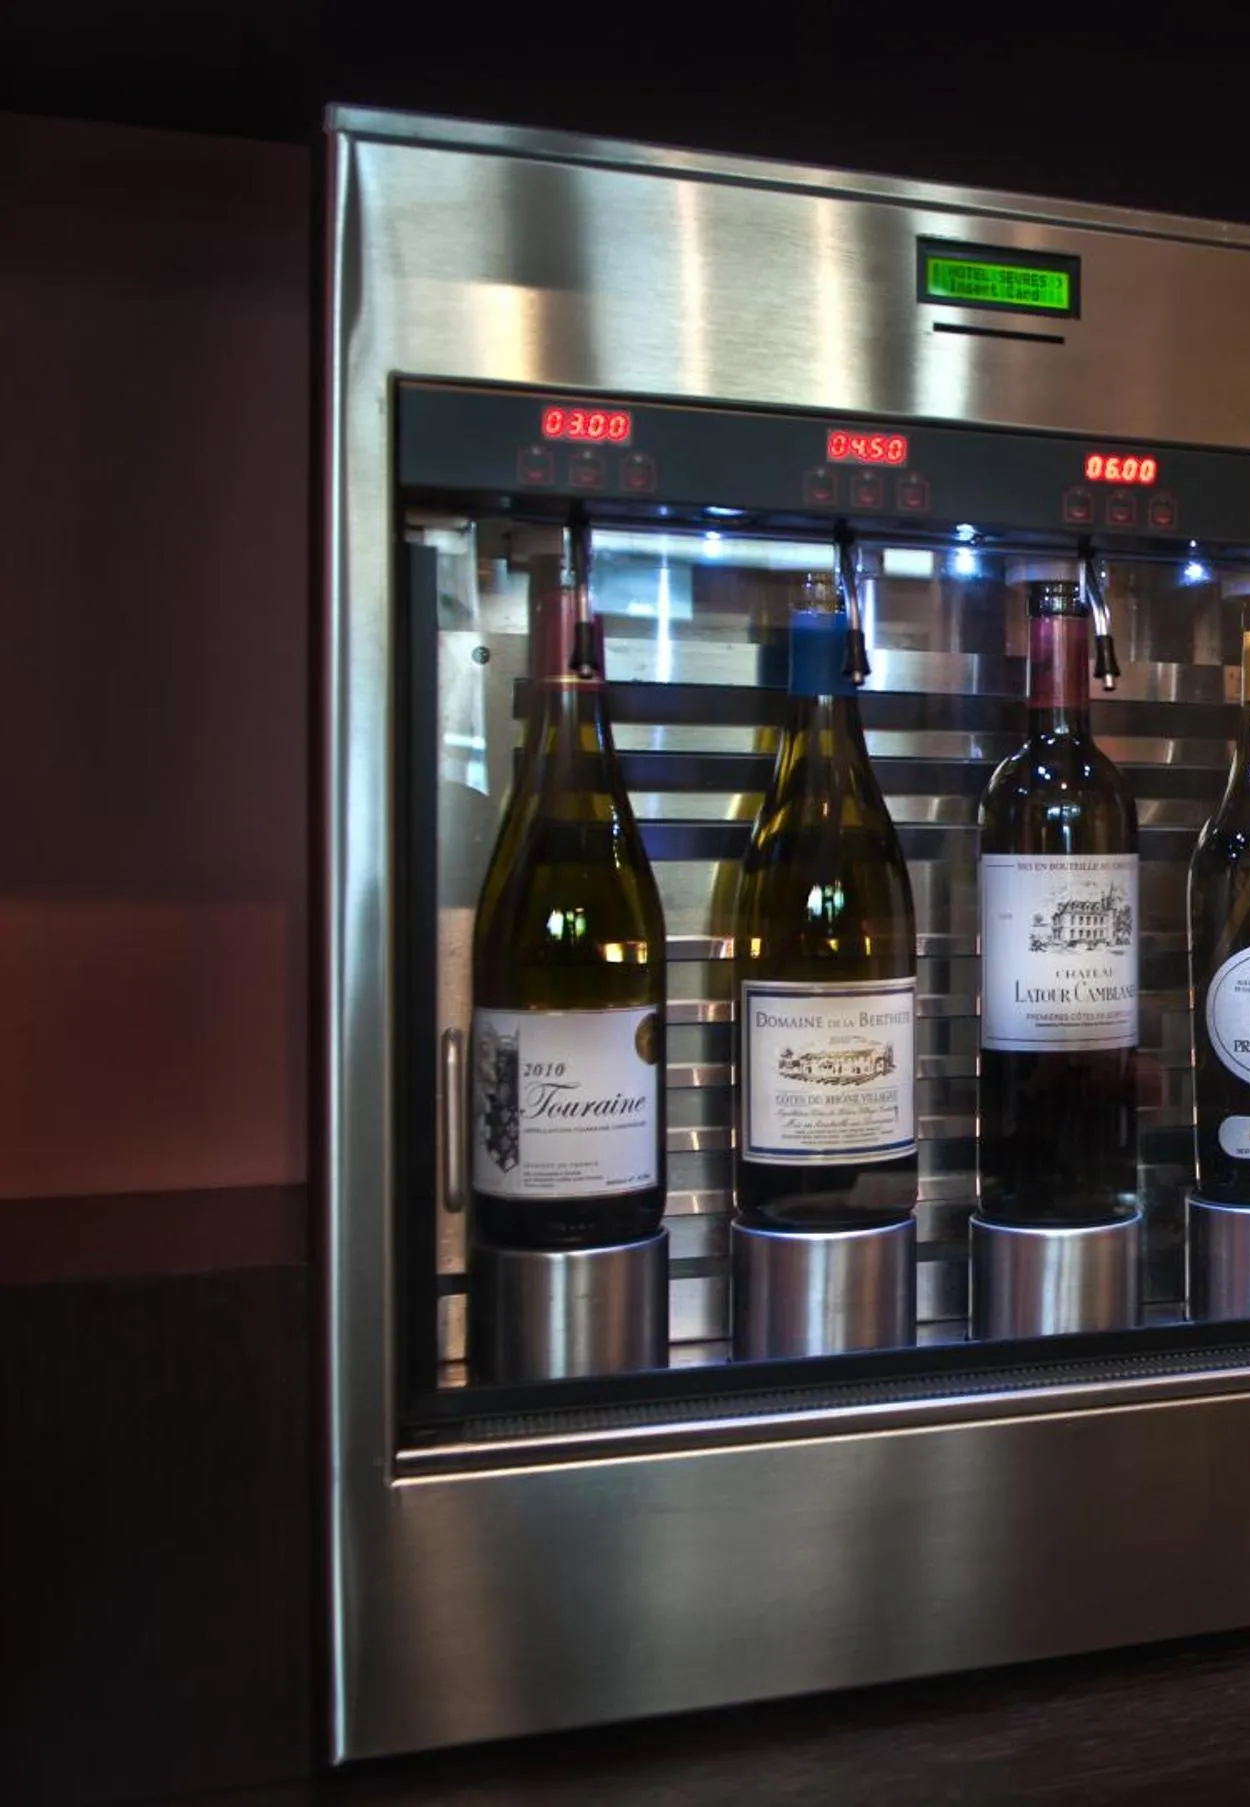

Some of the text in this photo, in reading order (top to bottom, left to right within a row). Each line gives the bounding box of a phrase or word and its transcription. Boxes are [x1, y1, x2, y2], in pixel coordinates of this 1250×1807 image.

[543, 408, 629, 440] 03.00
[1086, 455, 1156, 483] 06.00
[523, 1062, 566, 1078] 2010
[519, 1081, 647, 1120] Touraine
